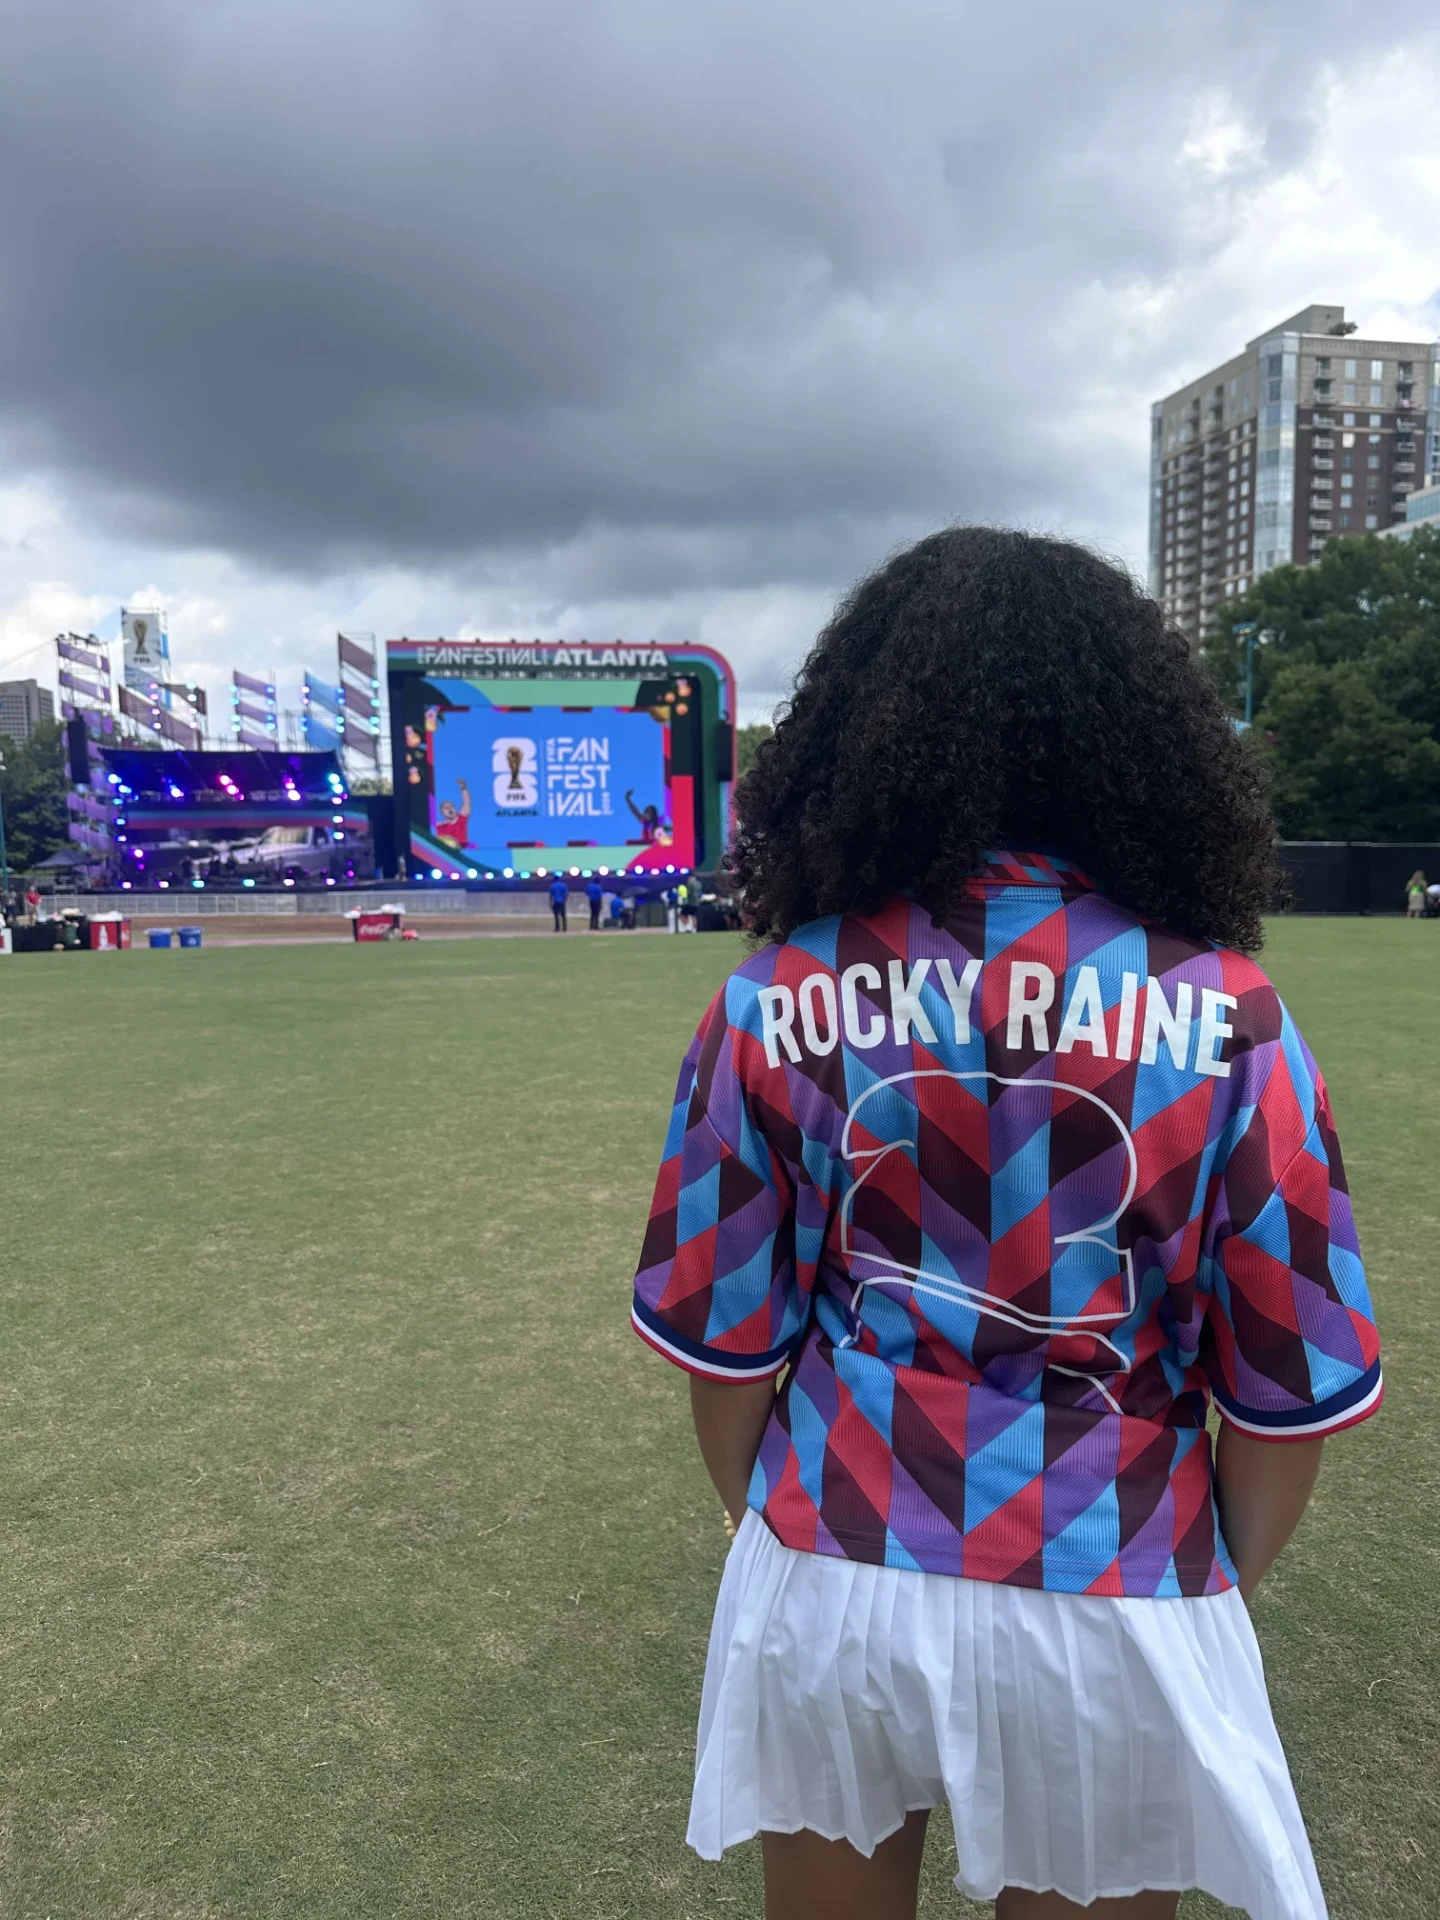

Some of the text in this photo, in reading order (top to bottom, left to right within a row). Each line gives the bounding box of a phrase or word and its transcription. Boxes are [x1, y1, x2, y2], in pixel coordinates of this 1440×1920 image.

[553, 648, 668, 667] ATLANTA
[557, 737, 609, 762] FAN
[547, 764, 611, 790] FEST
[506, 793, 527, 802] FIFA
[496, 809, 538, 817] ATLANTA
[757, 958, 1238, 1078] ROCKY RAINE
